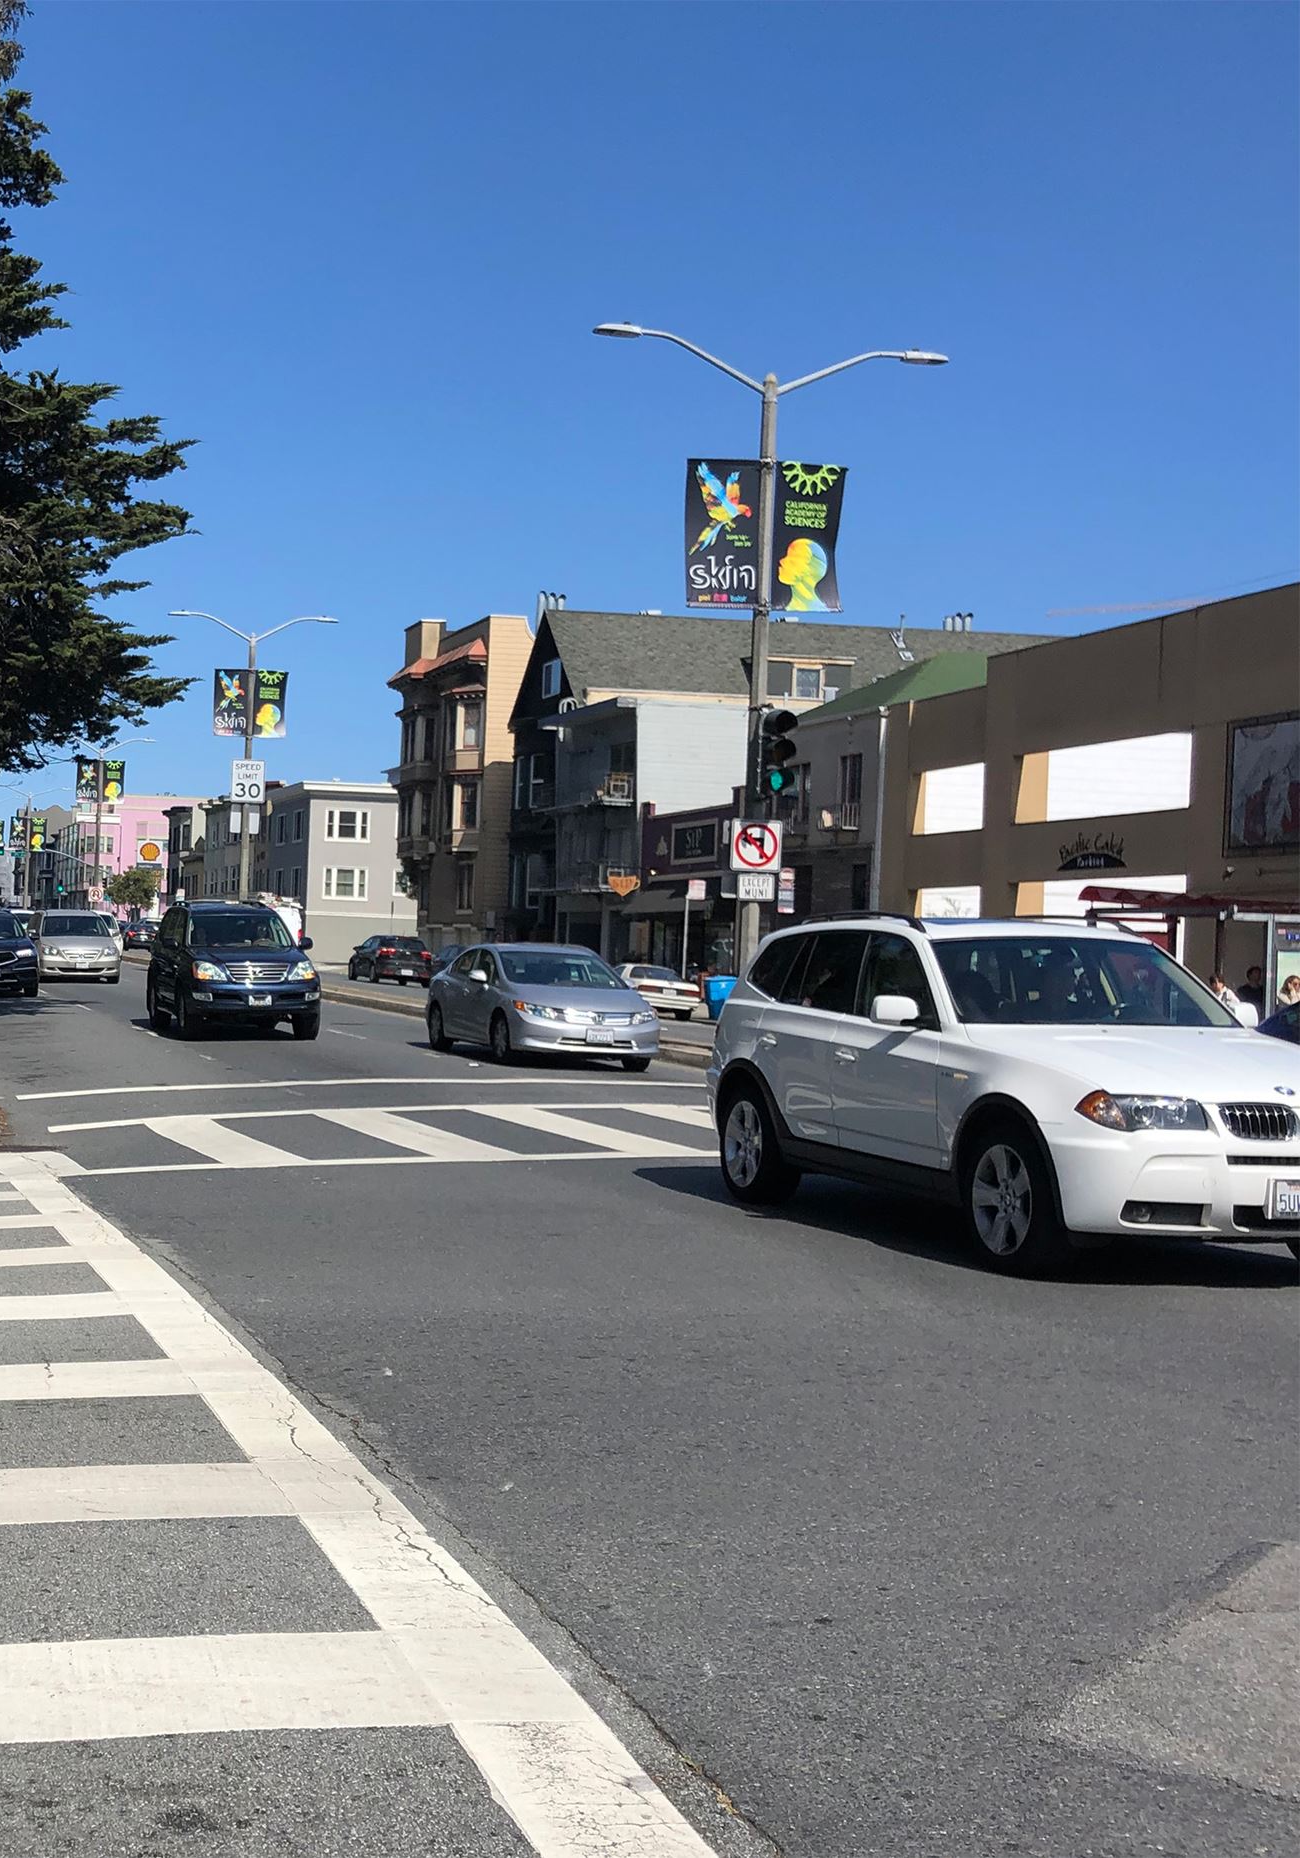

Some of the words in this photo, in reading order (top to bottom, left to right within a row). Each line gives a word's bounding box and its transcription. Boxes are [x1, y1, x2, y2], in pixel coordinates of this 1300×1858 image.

[785, 500, 827, 511] CALIFORNIA
[785, 508, 815, 518] ACADEMY
[816, 511, 827, 519] OF
[784, 516, 827, 529] SCIENCES
[689, 555, 756, 590] skin
[234, 783, 261, 798] 30
[742, 878, 770, 887] EXCEPT
[744, 888, 768, 898] MUNI
